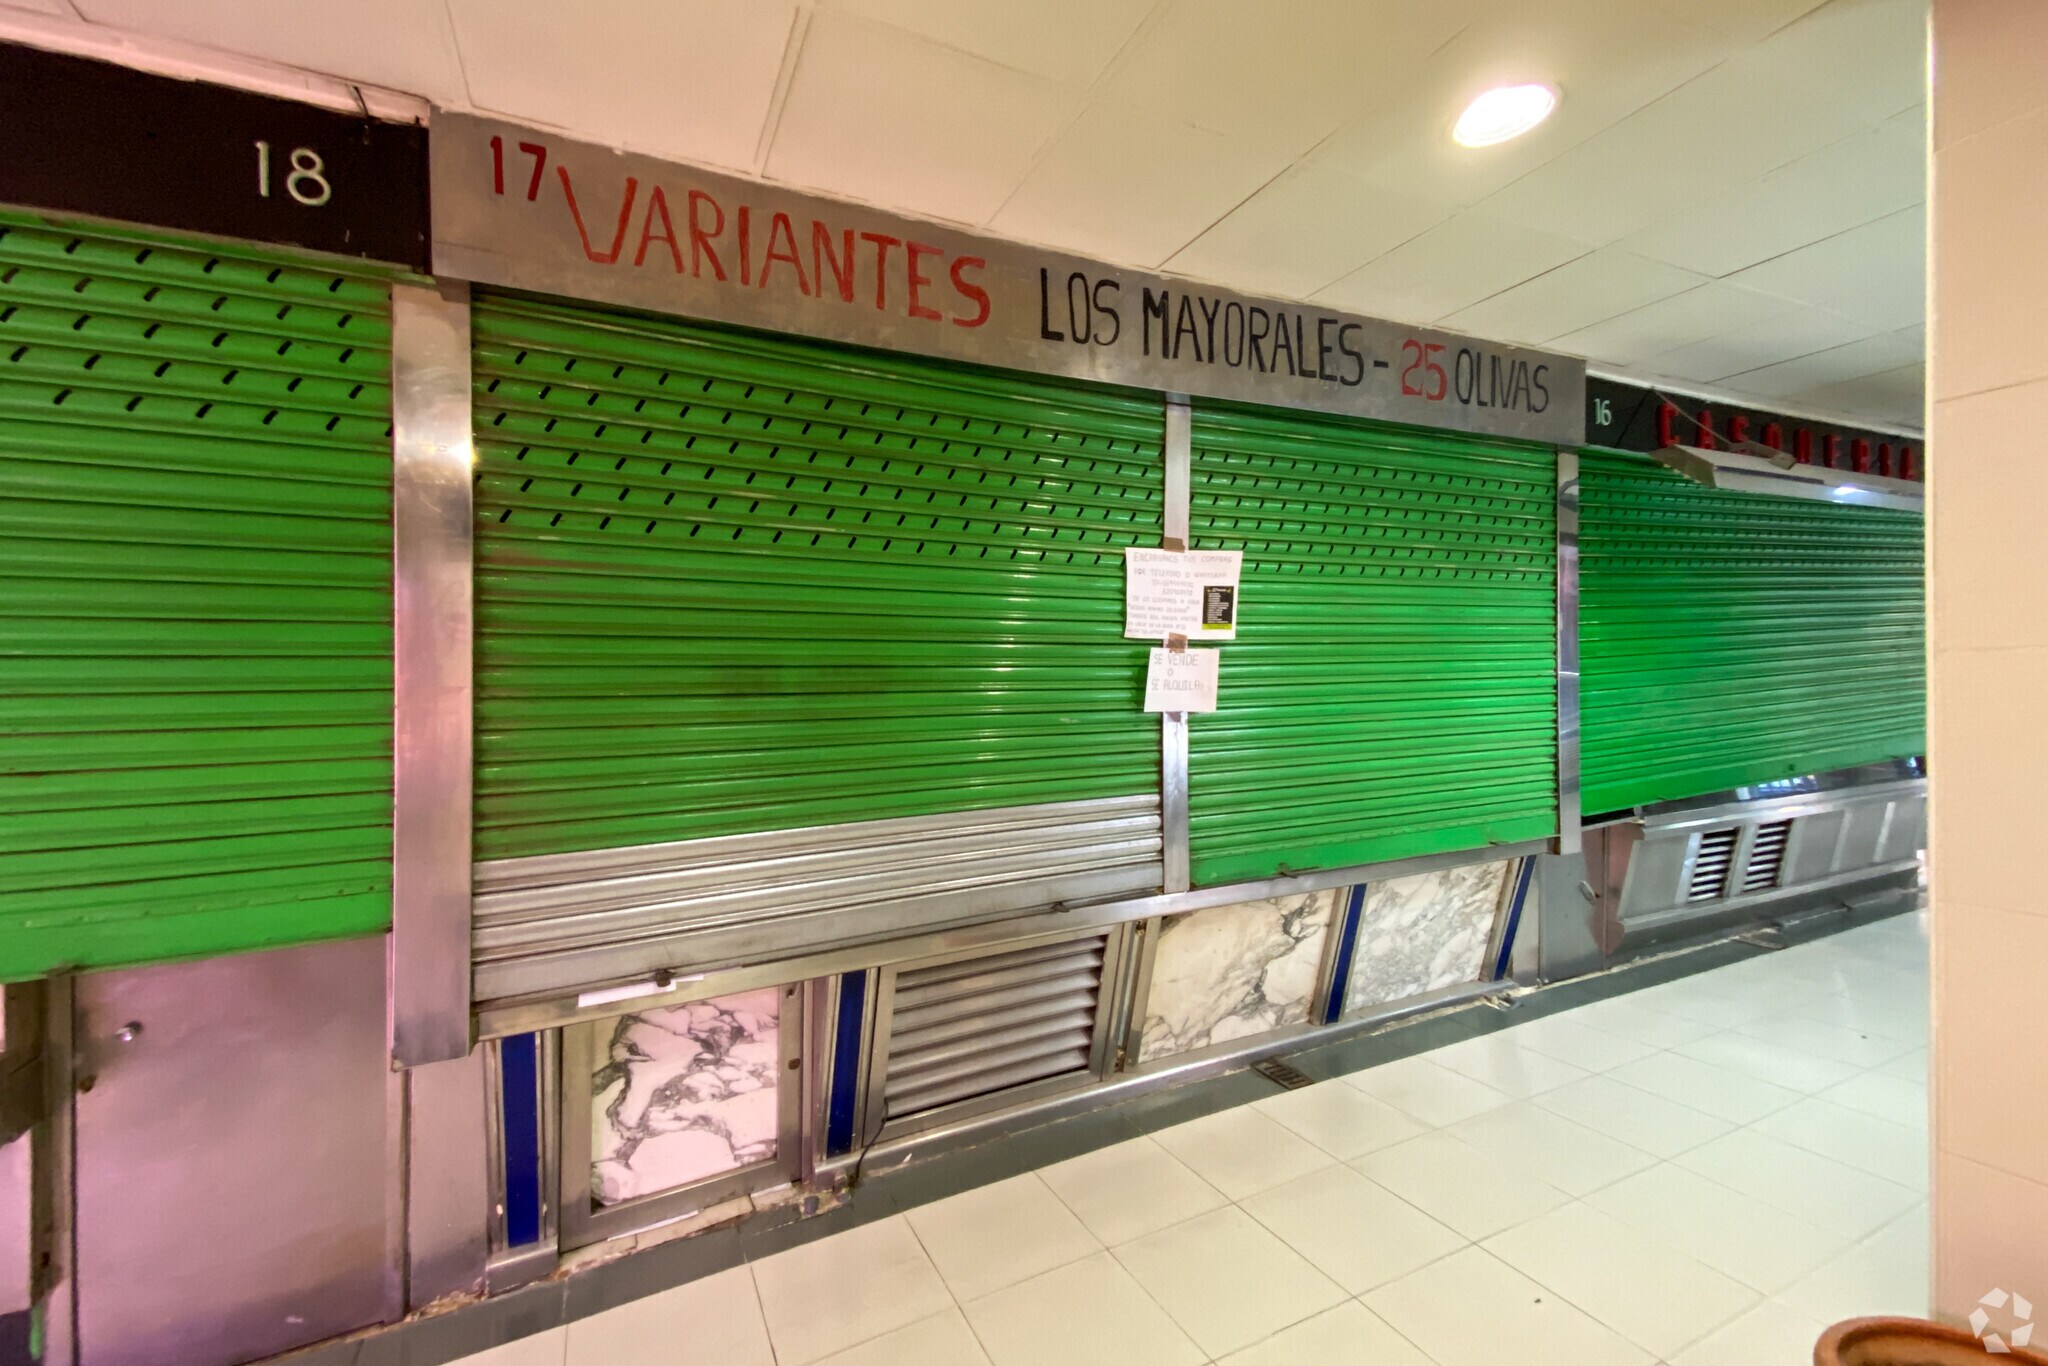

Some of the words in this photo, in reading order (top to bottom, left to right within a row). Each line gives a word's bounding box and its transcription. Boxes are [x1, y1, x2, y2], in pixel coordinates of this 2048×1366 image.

[255, 141, 331, 205] 18
[490, 135, 546, 200] 17
[557, 166, 991, 327] VARIANTES
[1040, 267, 1120, 346] LOS
[1402, 339, 1447, 400] 25
[1455, 348, 1550, 414] OLIVAS
[1594, 398, 1611, 426] 16
[1154, 653, 1163, 665] SE
[1168, 653, 1200, 666] VENDE
[1167, 668, 1174, 677] O
[1151, 678, 1160, 691] SE
